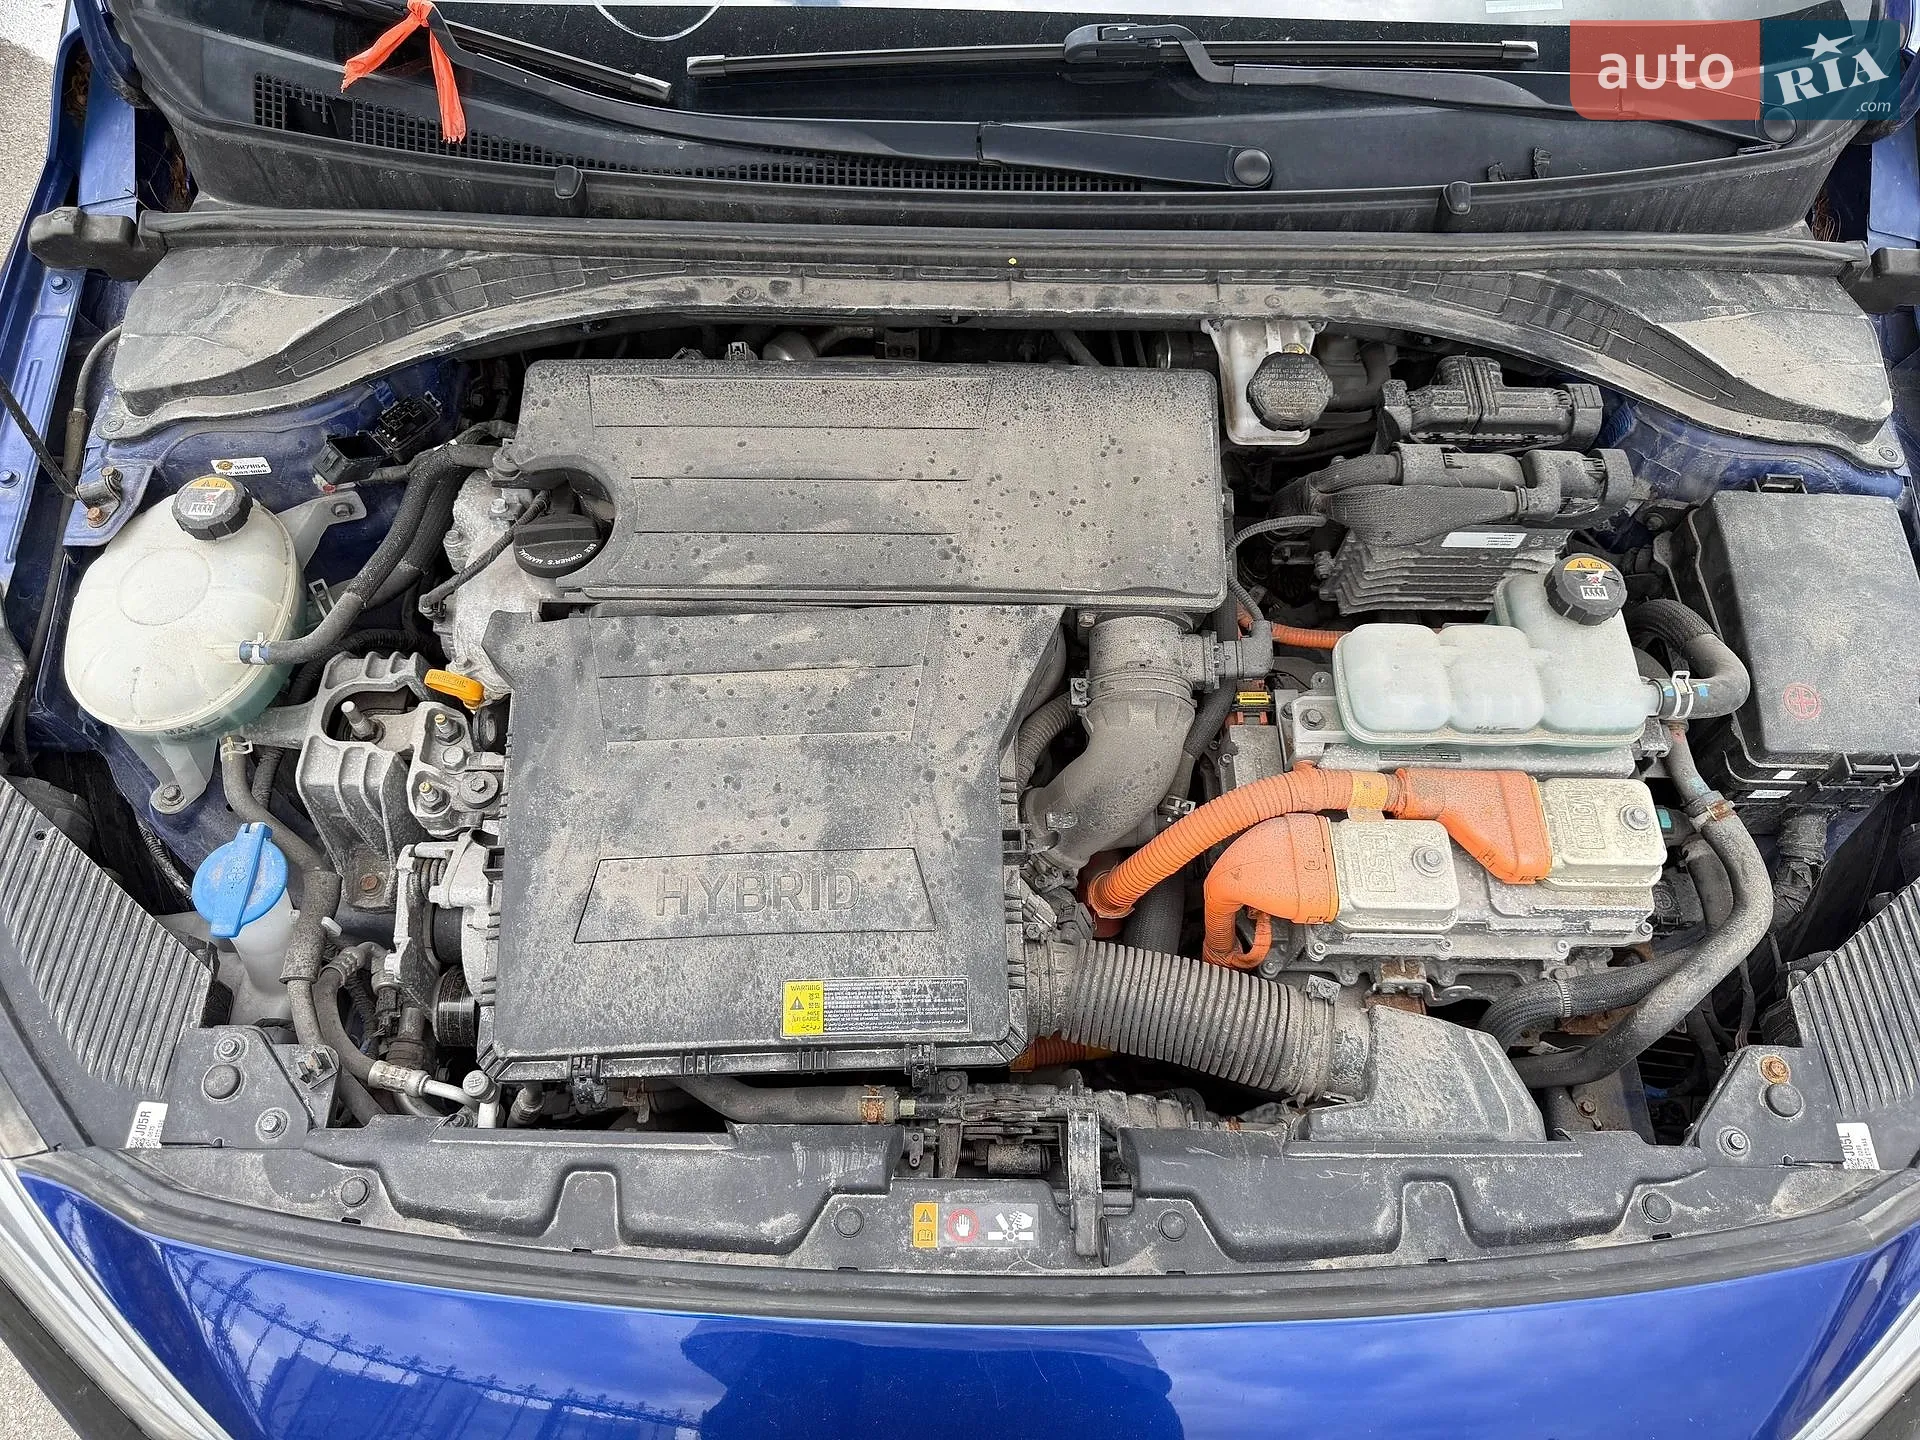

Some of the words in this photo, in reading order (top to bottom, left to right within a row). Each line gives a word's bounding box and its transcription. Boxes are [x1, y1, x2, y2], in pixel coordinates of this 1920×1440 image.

[518, 548, 544, 564] MANUAL
[546, 553, 583, 565] OWNER'S
[656, 868, 860, 916] HYBRID
[790, 984, 821, 992] WARNING
[135, 1111, 152, 1136] J05R
[1839, 1132, 1855, 1157] J05L
